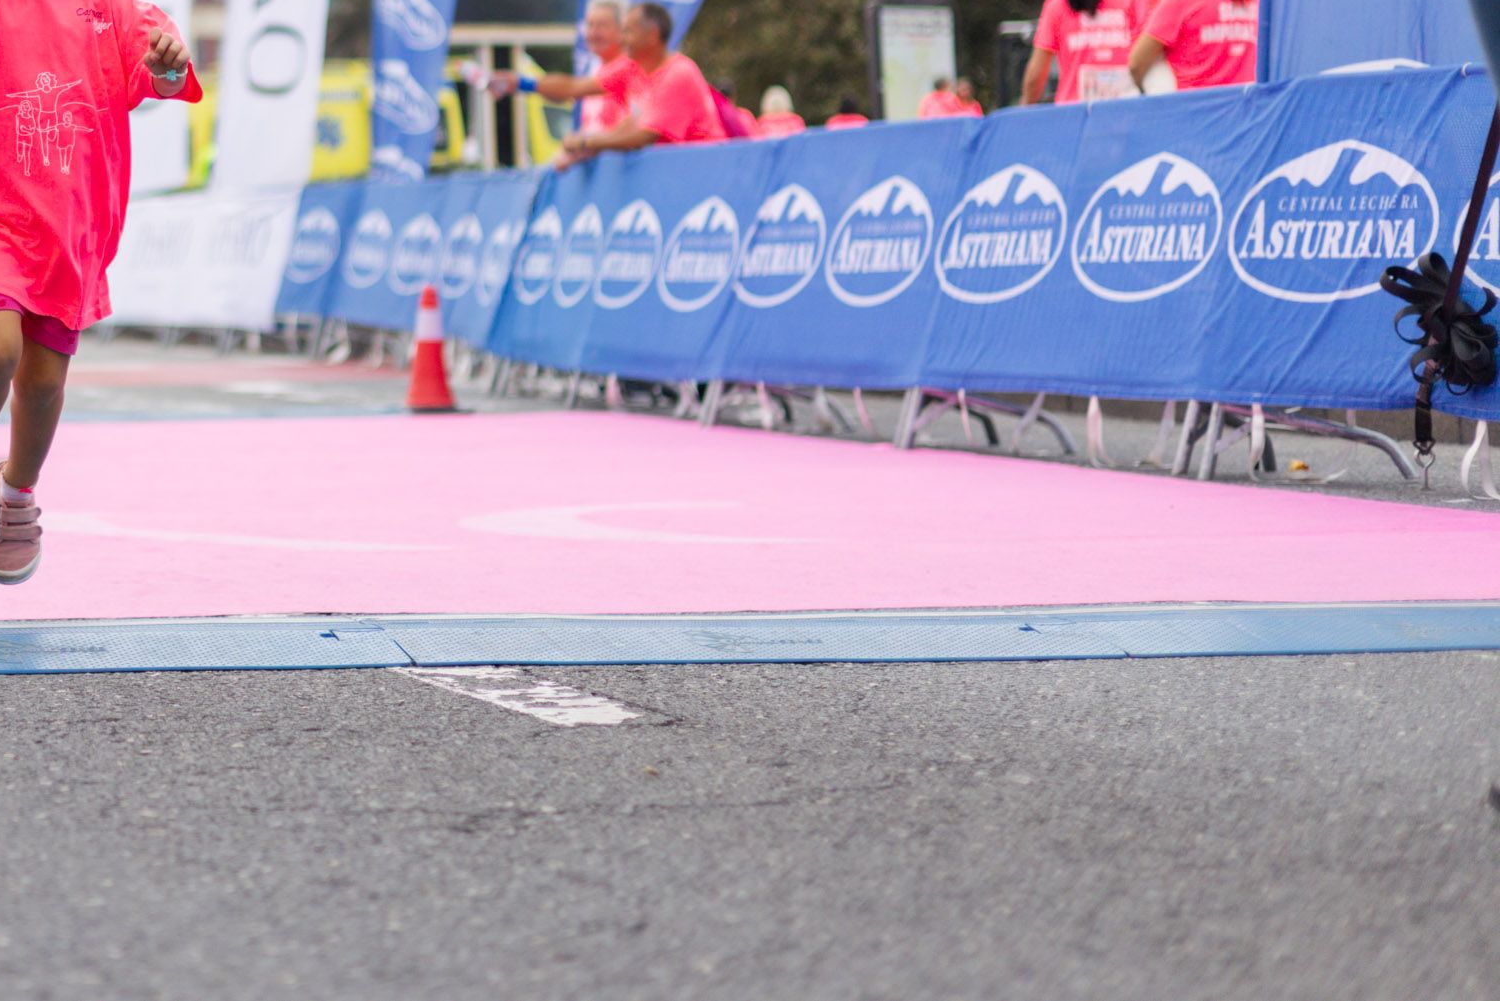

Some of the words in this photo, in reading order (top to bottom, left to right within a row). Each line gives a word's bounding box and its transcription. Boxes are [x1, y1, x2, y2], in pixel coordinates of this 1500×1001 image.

[1239, 200, 1416, 260] ASTURIANA
[1278, 195, 1343, 212] CENTRAL
[832, 224, 921, 274] ASTURIANA
[944, 217, 1052, 270] ASTURIANA
[1080, 206, 1206, 263] ASTURIANA
